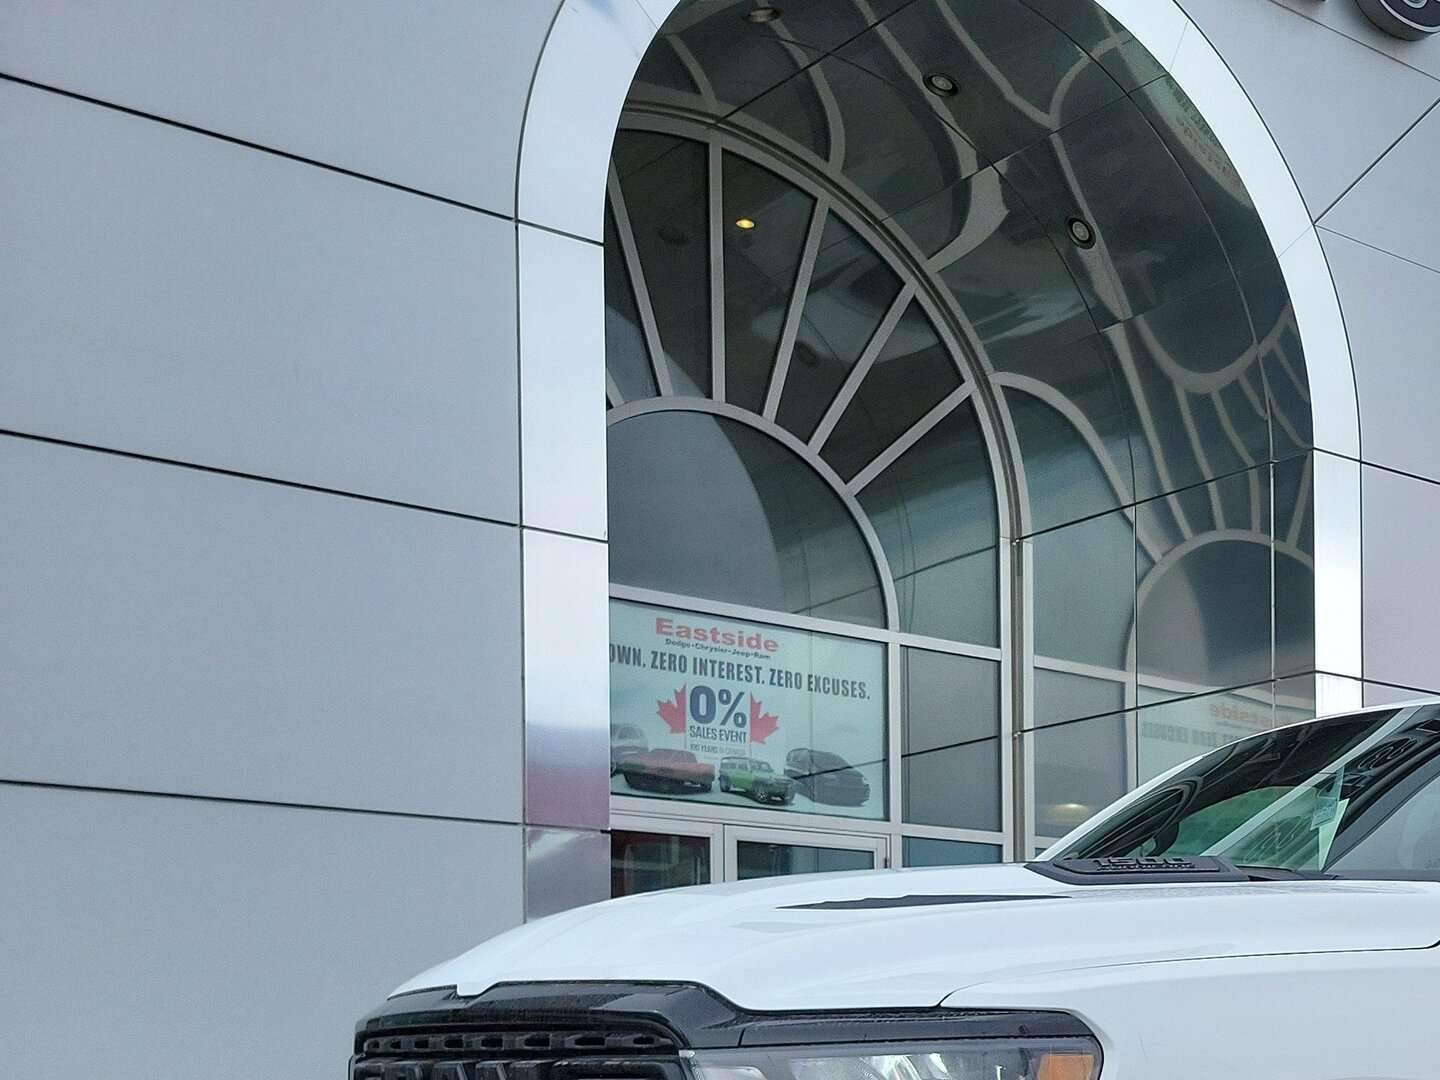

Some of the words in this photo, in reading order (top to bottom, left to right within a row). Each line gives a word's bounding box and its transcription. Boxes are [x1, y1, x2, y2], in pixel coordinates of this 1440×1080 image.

[655, 617, 779, 652] Eastside
[650, 650, 687, 674] ZERO
[692, 657, 765, 685] INTEREST.
[769, 668, 803, 690] ZERO
[807, 673, 871, 700] EXCUSES.
[689, 685, 747, 728] 0%
[689, 725, 718, 741] SALES
[719, 728, 748, 744] EVENT
